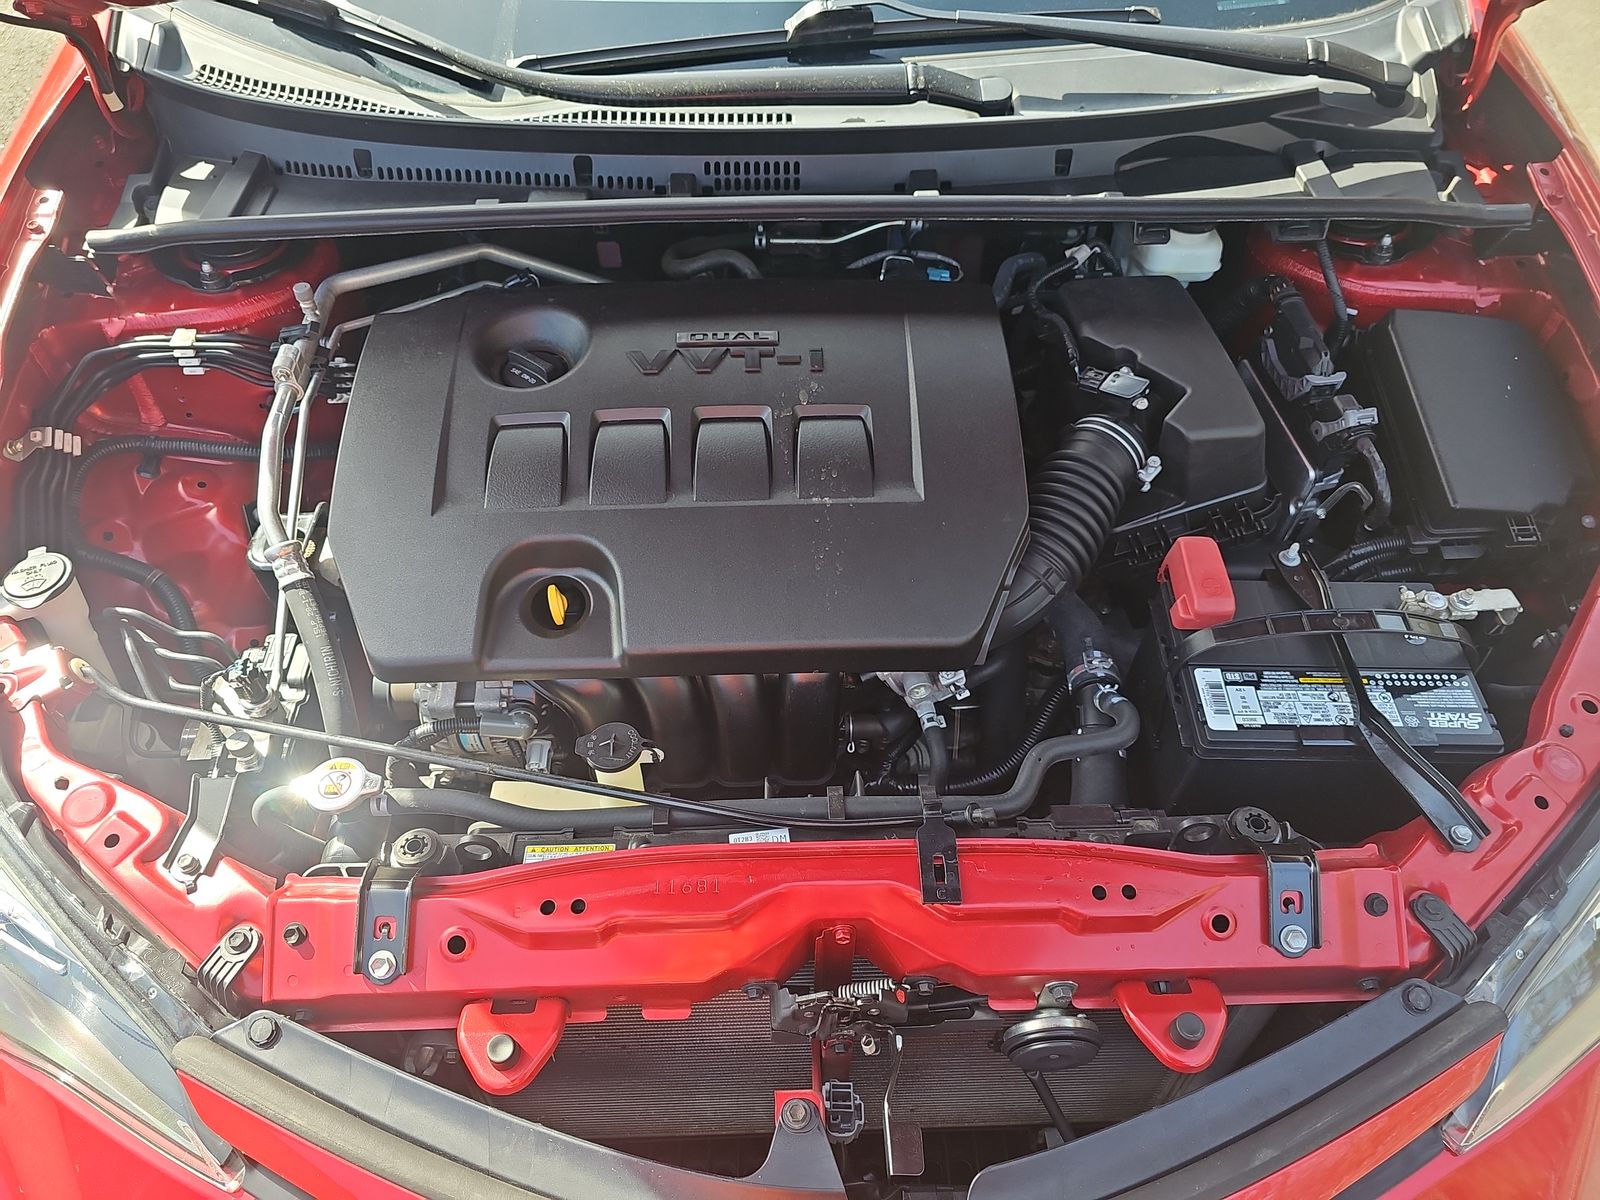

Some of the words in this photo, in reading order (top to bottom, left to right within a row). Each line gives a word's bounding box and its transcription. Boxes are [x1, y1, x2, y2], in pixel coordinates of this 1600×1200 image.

[689, 331, 770, 342] DUAL
[1426, 712, 1483, 723] START
[1428, 719, 1480, 730] SUPER
[771, 834, 787, 843] DM
[653, 878, 720, 895] 11681
